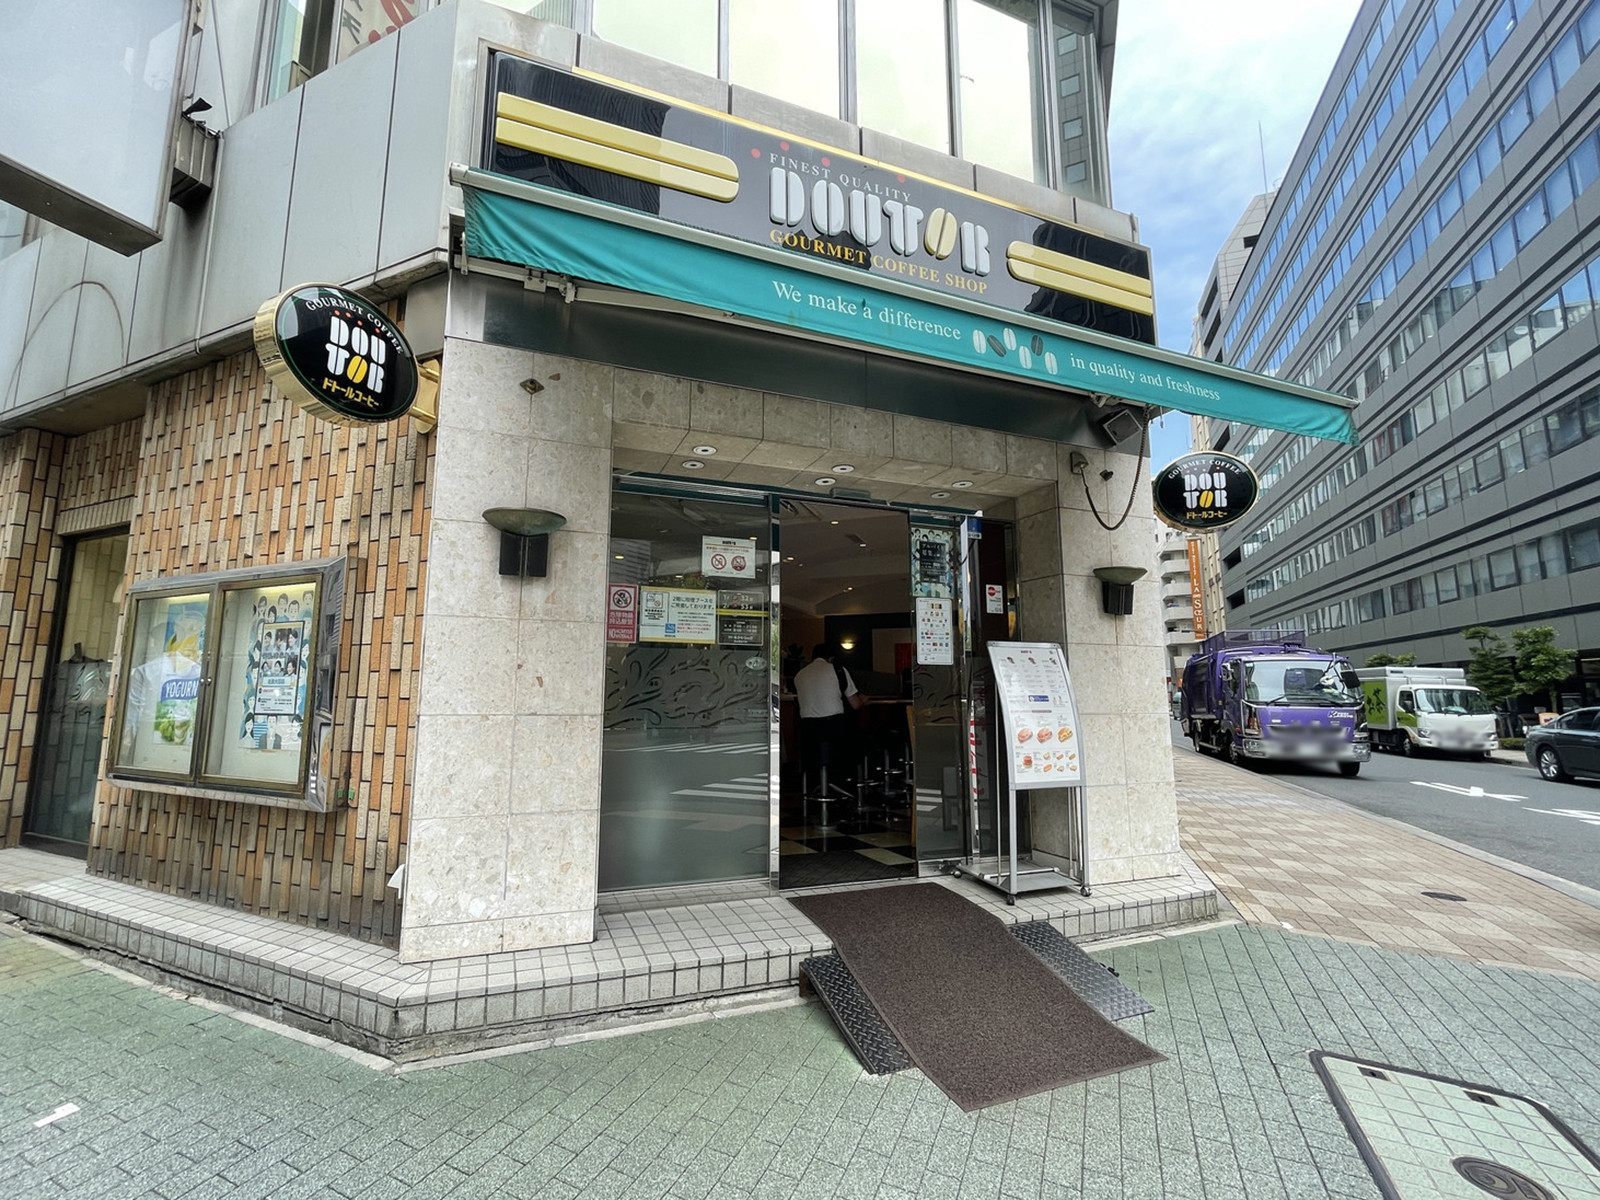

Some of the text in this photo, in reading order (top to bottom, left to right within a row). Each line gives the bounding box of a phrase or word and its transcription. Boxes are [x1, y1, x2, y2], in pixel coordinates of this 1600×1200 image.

[770, 153, 911, 202] FINEST QUALITY
[769, 166, 991, 276] DOUTOR
[769, 229, 988, 294] GOURMET COFFEE SHOP
[305, 298, 404, 354] GOURMET COFFEE
[772, 281, 961, 340] We make a difference
[330, 315, 386, 366] DOU
[325, 343, 385, 394] TOR
[1070, 353, 1221, 401] in quality and freshness
[322, 377, 380, 409] ドトールコーヒー
[1168, 459, 1242, 479] GOURMET COFFEE
[1184, 472, 1226, 491] DOU
[1182, 489, 1228, 509] TOR
[1186, 511, 1228, 519] ドトールコーヒー
[165, 681, 199, 698] YOGURN
